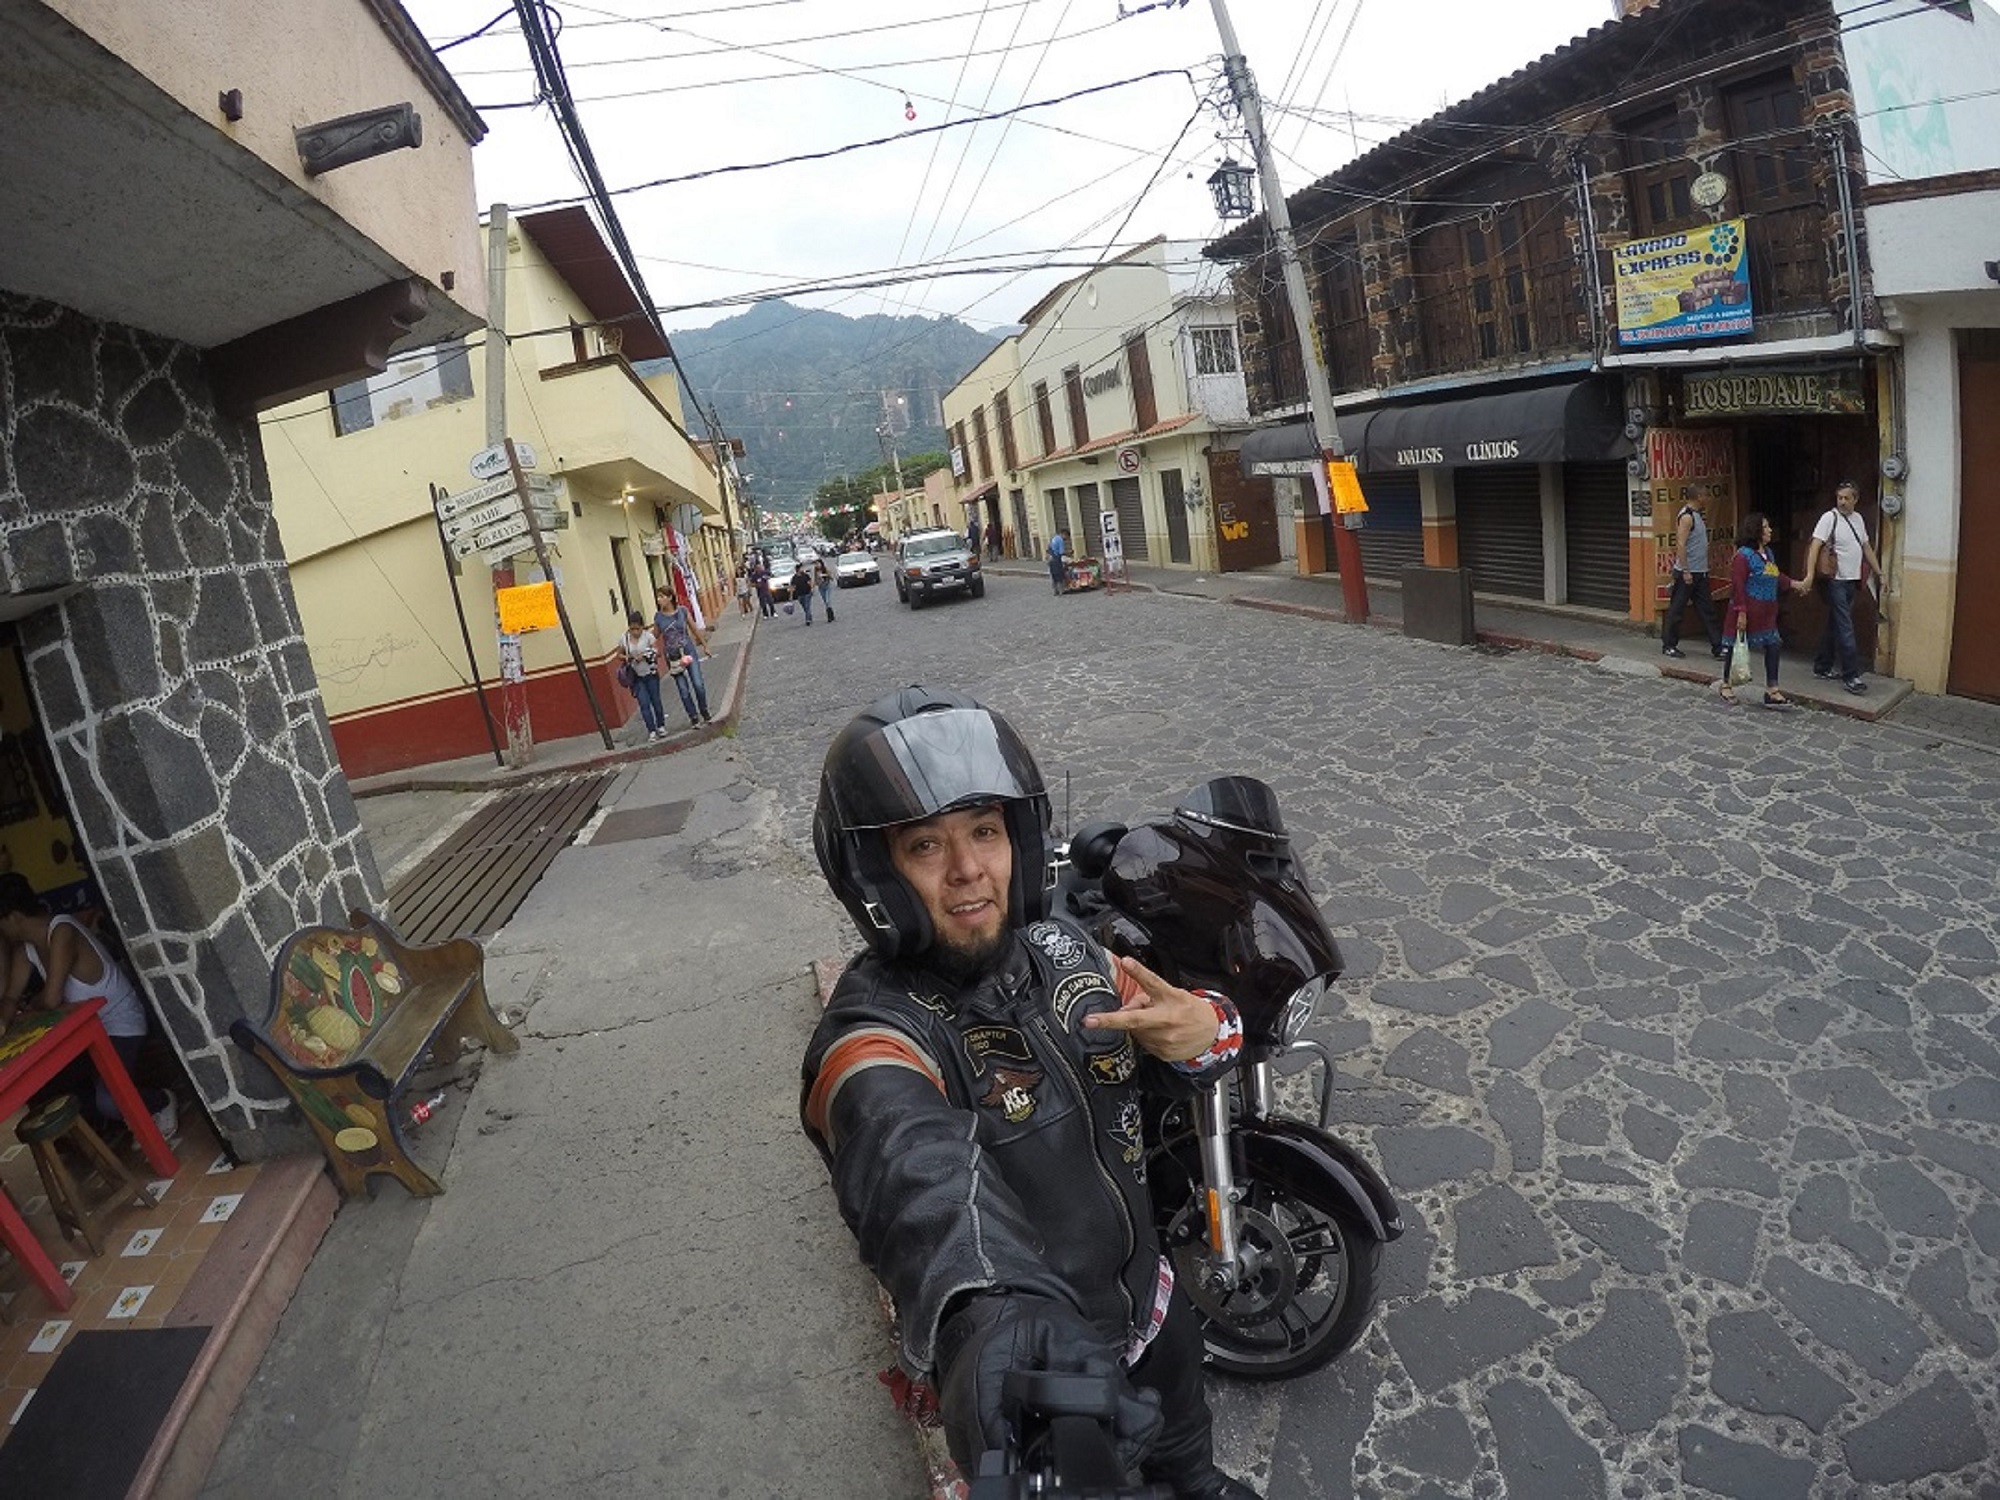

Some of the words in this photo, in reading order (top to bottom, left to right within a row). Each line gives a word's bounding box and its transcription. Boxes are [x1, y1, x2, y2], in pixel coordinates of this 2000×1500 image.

[1616, 234, 1688, 258] LAVADO
[1618, 250, 1701, 277] EXPRESS
[1689, 375, 1820, 409] HOSPEDAJE
[1656, 487, 1676, 503] EL
[1103, 513, 1116, 534] E
[1221, 521, 1249, 541] WC
